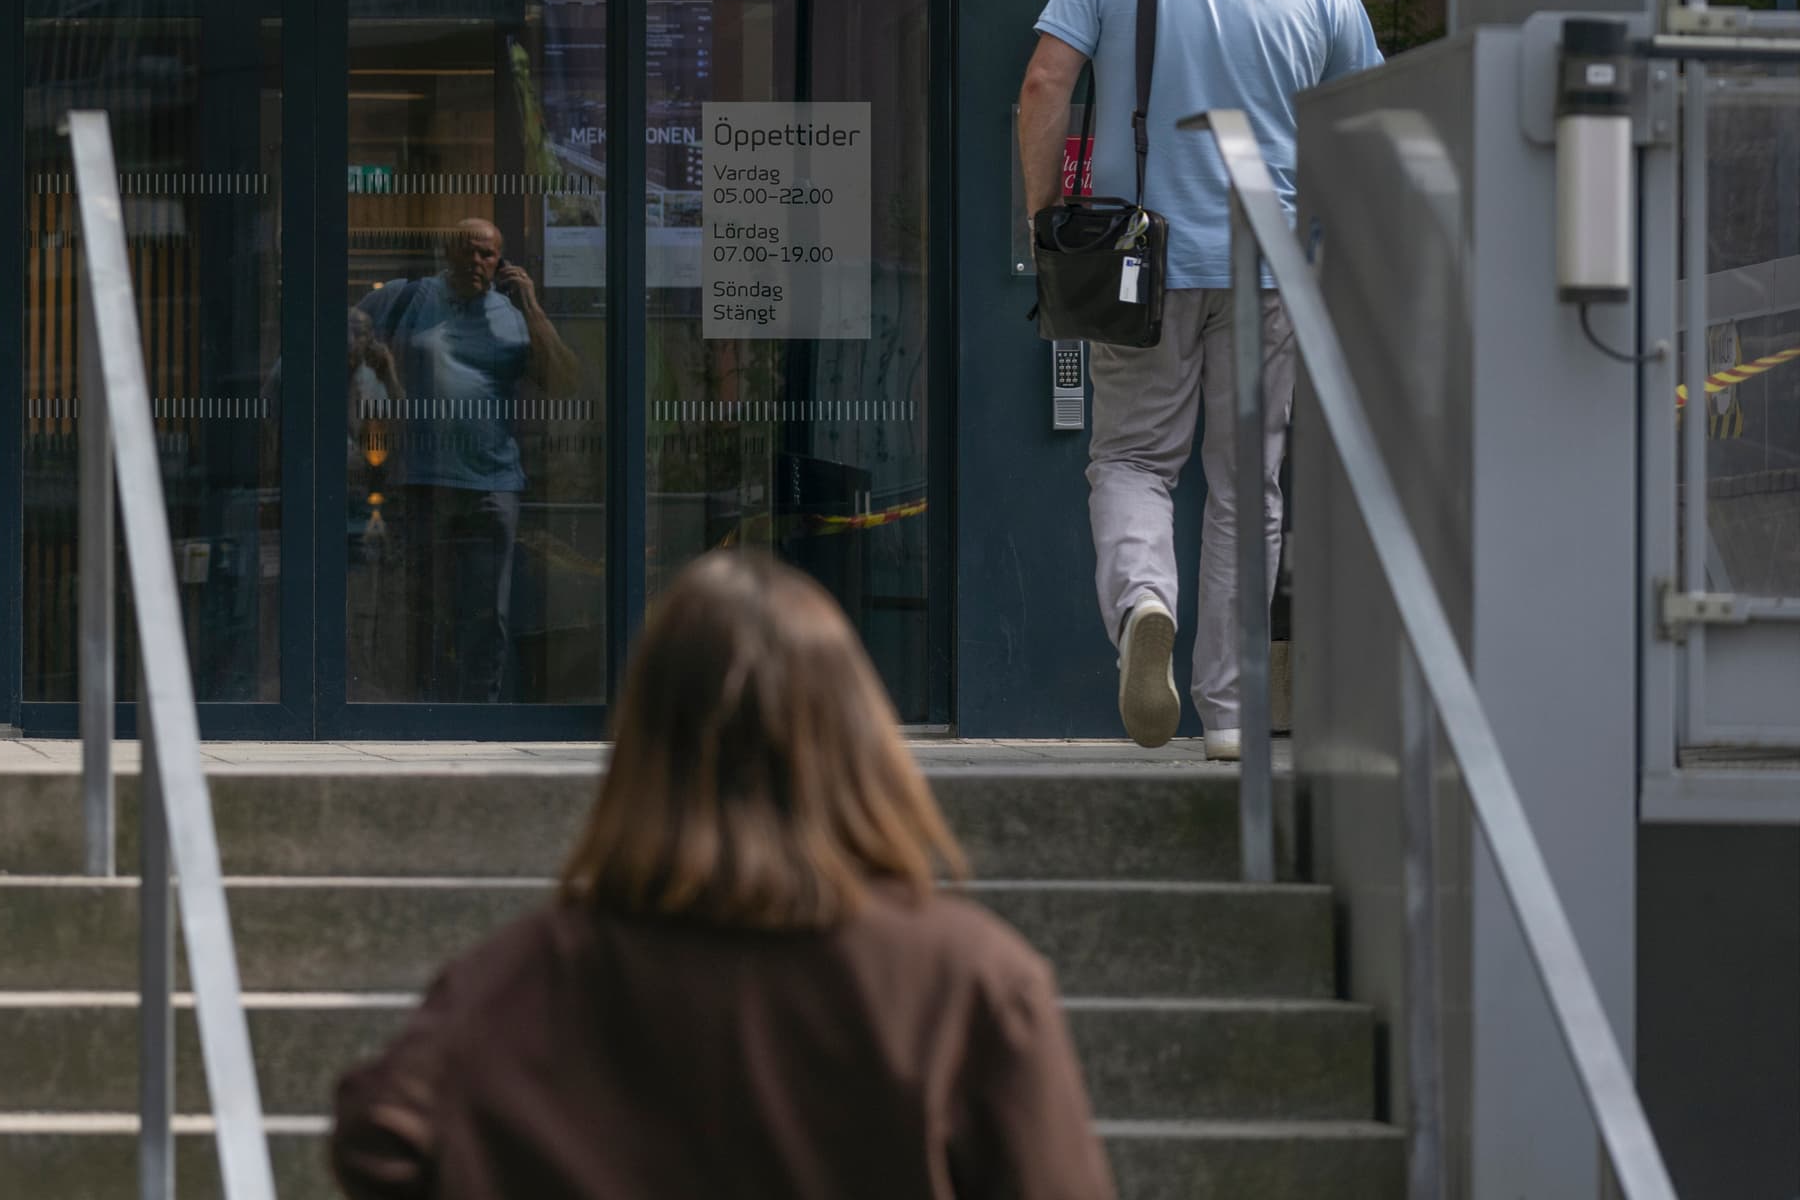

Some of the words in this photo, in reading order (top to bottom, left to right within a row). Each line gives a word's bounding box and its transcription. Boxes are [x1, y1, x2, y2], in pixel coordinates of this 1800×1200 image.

[714, 117, 861, 151] Öppettider
[713, 165, 781, 185] Vardag
[713, 223, 779, 243] Lördag
[713, 281, 784, 302] Söndag
[713, 304, 777, 325] Stängt
